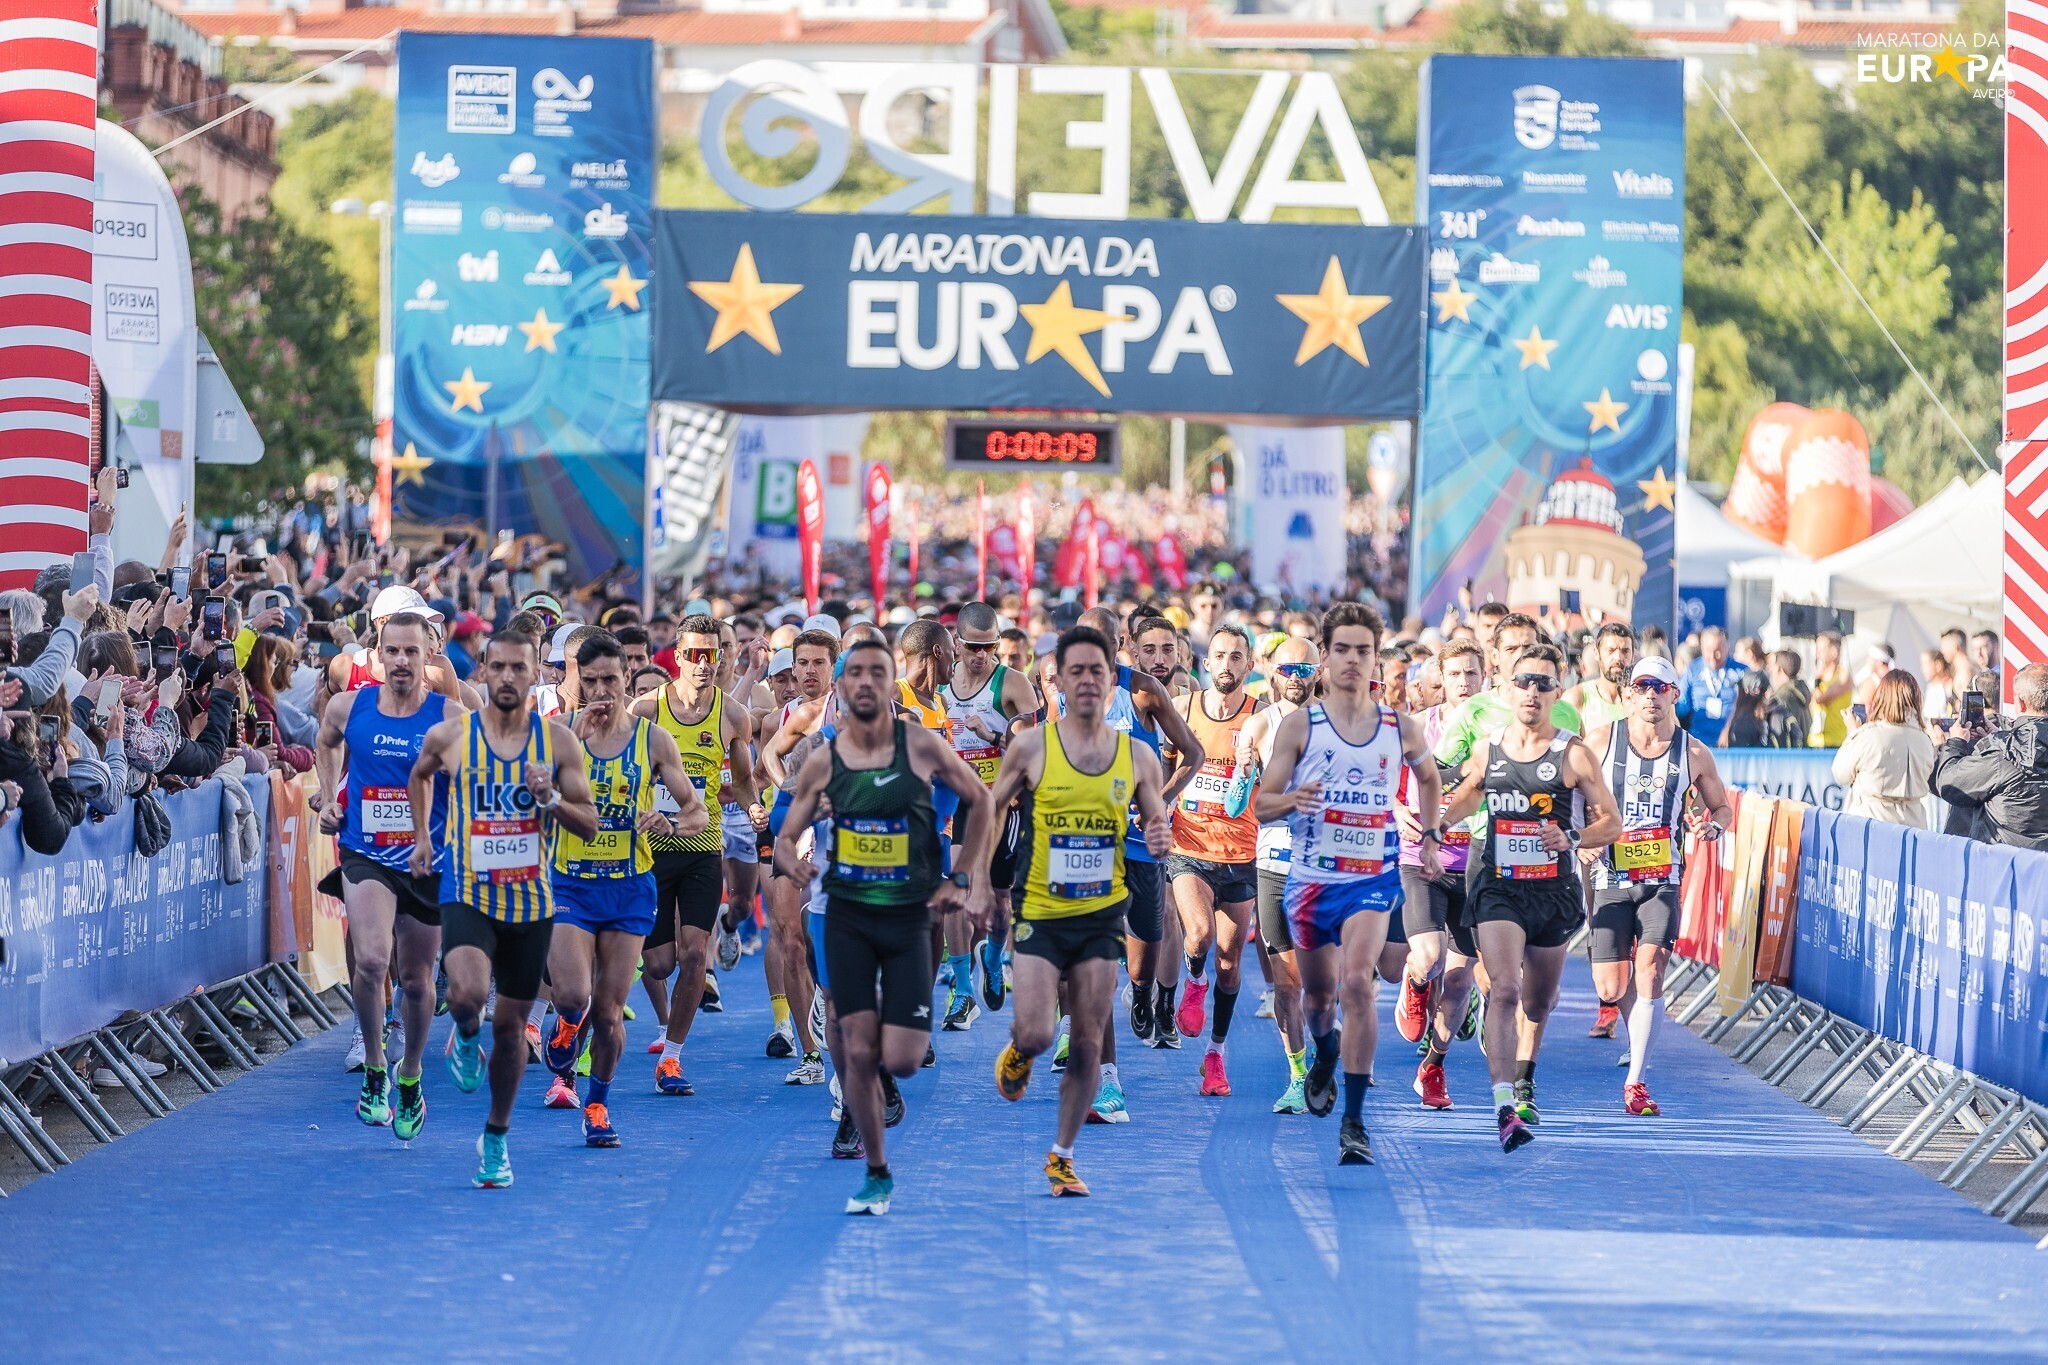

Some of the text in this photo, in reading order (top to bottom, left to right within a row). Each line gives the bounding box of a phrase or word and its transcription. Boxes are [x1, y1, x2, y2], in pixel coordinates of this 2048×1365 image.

[1612, 168, 1675, 195] Vitalis
[1516, 215, 1586, 237] Auchan
[849, 232, 1161, 278] MARATONA DA
[457, 249, 500, 282] tvi
[1604, 303, 1669, 330] AVIS
[846, 279, 1235, 377] EURPA
[986, 430, 1097, 462] 0:00:09
[386, 735, 409, 747] Prifer
[963, 752, 987, 760] EURPA
[1205, 757, 1237, 767] eralta
[378, 792, 408, 800] EURPA
[475, 782, 537, 814] LKO
[1324, 787, 1369, 805] ÁZARO
[854, 825, 888, 833] EURPA
[1045, 814, 1120, 832] U.D. VÁRZE
[1341, 816, 1372, 826] EURPA
[489, 825, 523, 834] EURPA
[1334, 828, 1376, 847] 8408
[1628, 833, 1655, 841] EURPA
[363, 834, 374, 843] VIP
[483, 838, 529, 855] 8645
[582, 834, 617, 849] 1248
[853, 837, 893, 854] 1628
[1068, 840, 1100, 848] EURPA
[1624, 842, 1661, 858] 8529
[569, 863, 580, 871] VIP
[1064, 853, 1103, 869] 1086
[1325, 860, 1336, 869] VIP
